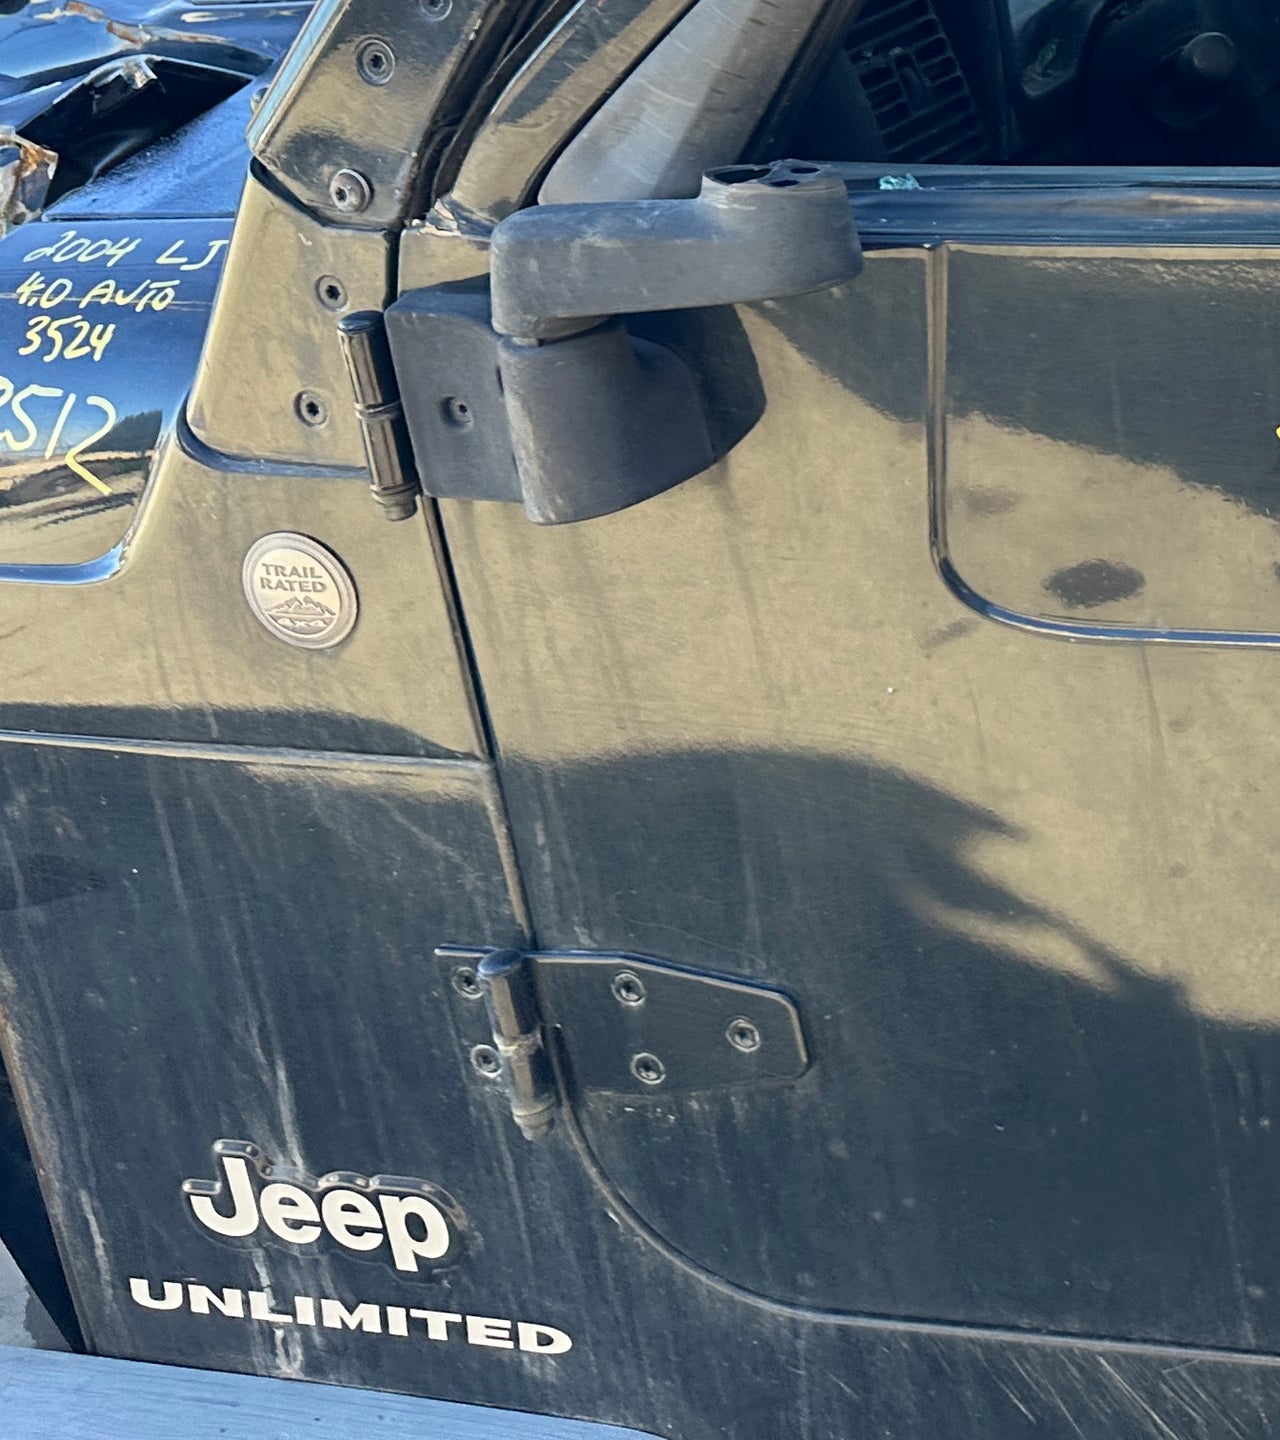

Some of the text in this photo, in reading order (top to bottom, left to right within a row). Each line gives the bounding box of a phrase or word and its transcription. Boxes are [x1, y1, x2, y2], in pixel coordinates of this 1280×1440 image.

[23, 230, 229, 271] 2004 LJ
[18, 314, 116, 363] 3524
[259, 576, 328, 593] RATED
[261, 563, 323, 579] TRAIL
[189, 1157, 451, 1272] Jeep
[129, 1277, 574, 1356] UNLIMITED
